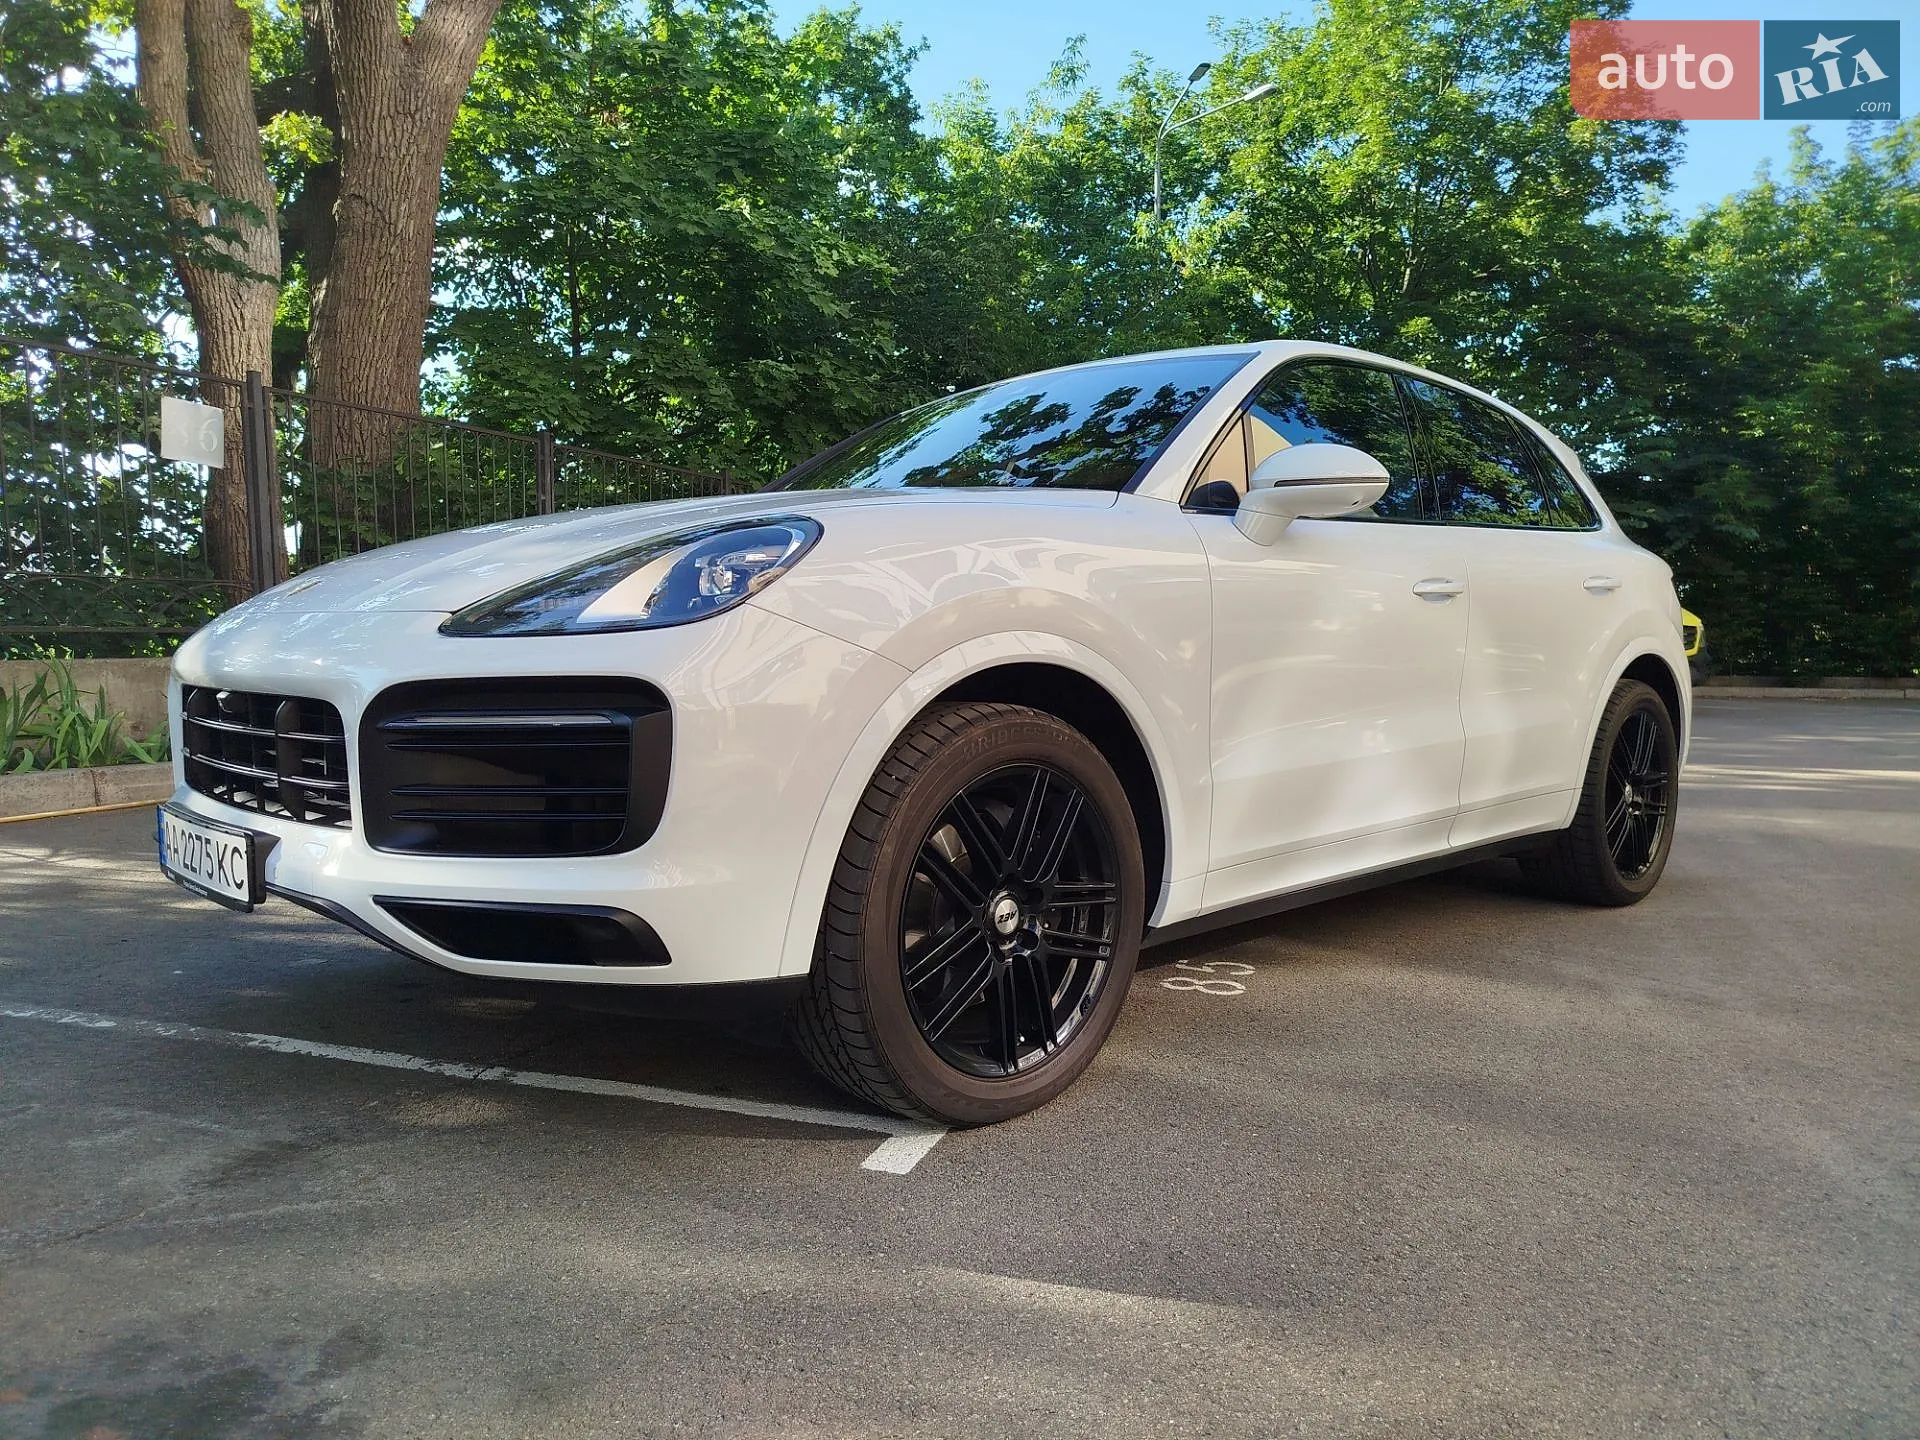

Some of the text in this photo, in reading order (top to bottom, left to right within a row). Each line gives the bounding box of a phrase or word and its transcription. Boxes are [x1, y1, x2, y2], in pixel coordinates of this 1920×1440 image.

[165, 821, 245, 890] AA 2275 KC
